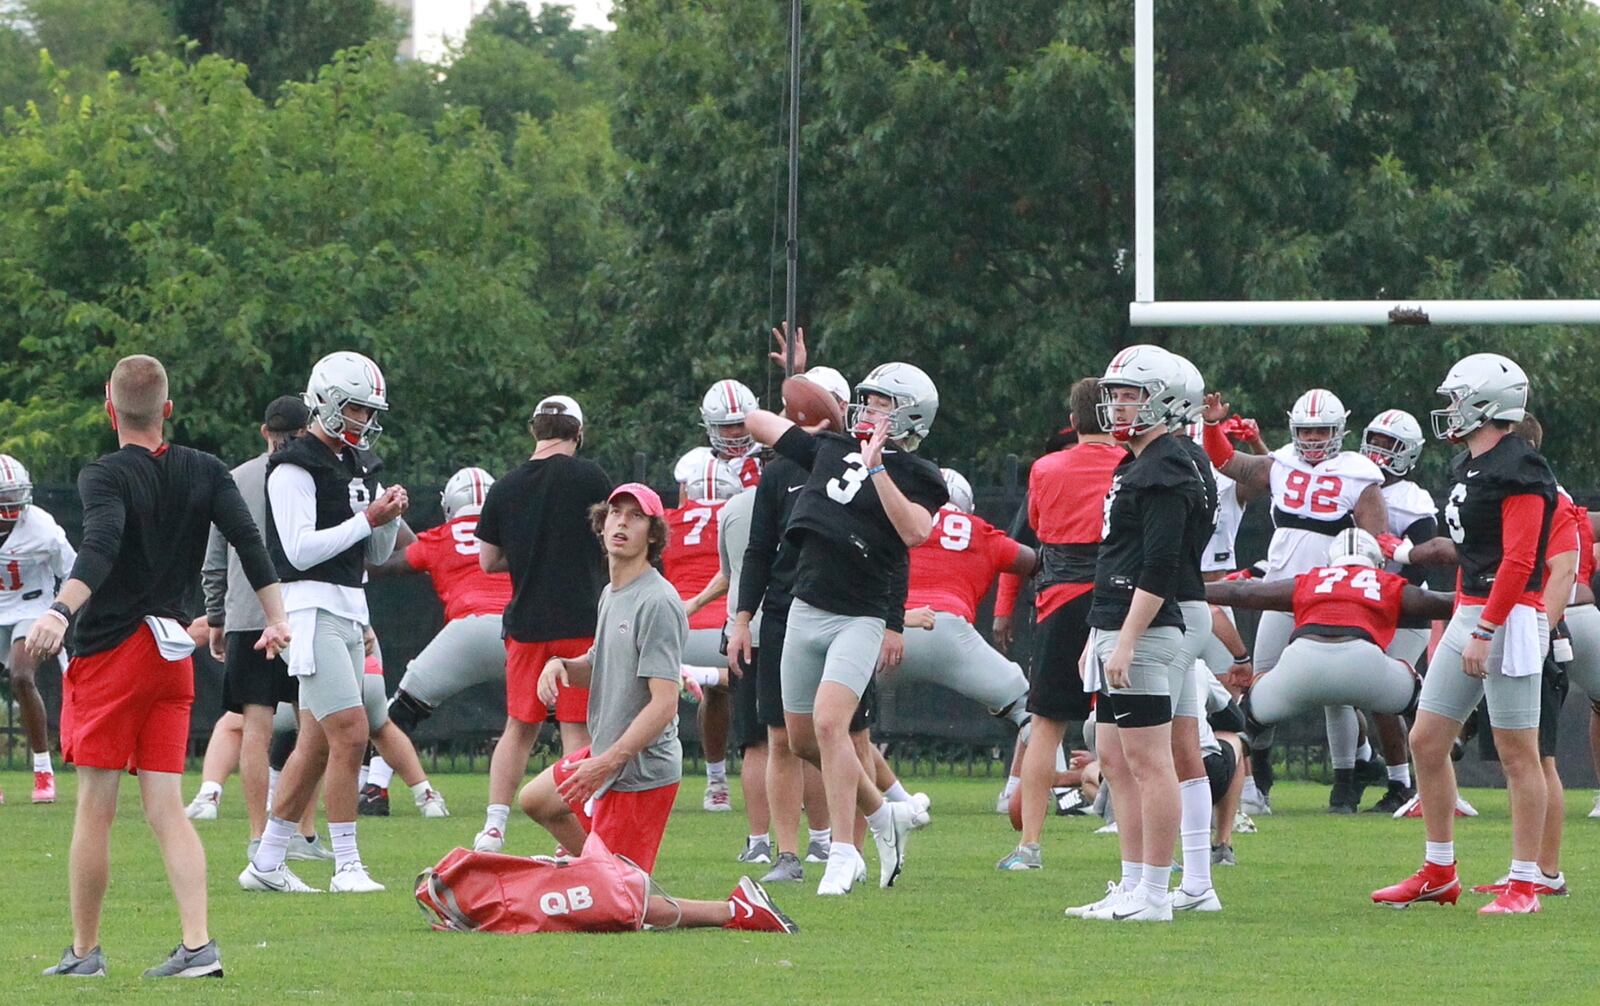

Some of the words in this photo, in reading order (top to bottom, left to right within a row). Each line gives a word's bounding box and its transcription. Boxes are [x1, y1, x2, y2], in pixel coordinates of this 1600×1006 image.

[826, 452, 869, 504] 3
[1285, 468, 1341, 512] 92
[683, 508, 719, 546] 7
[1315, 568, 1381, 600] 74
[540, 885, 593, 917] QB
